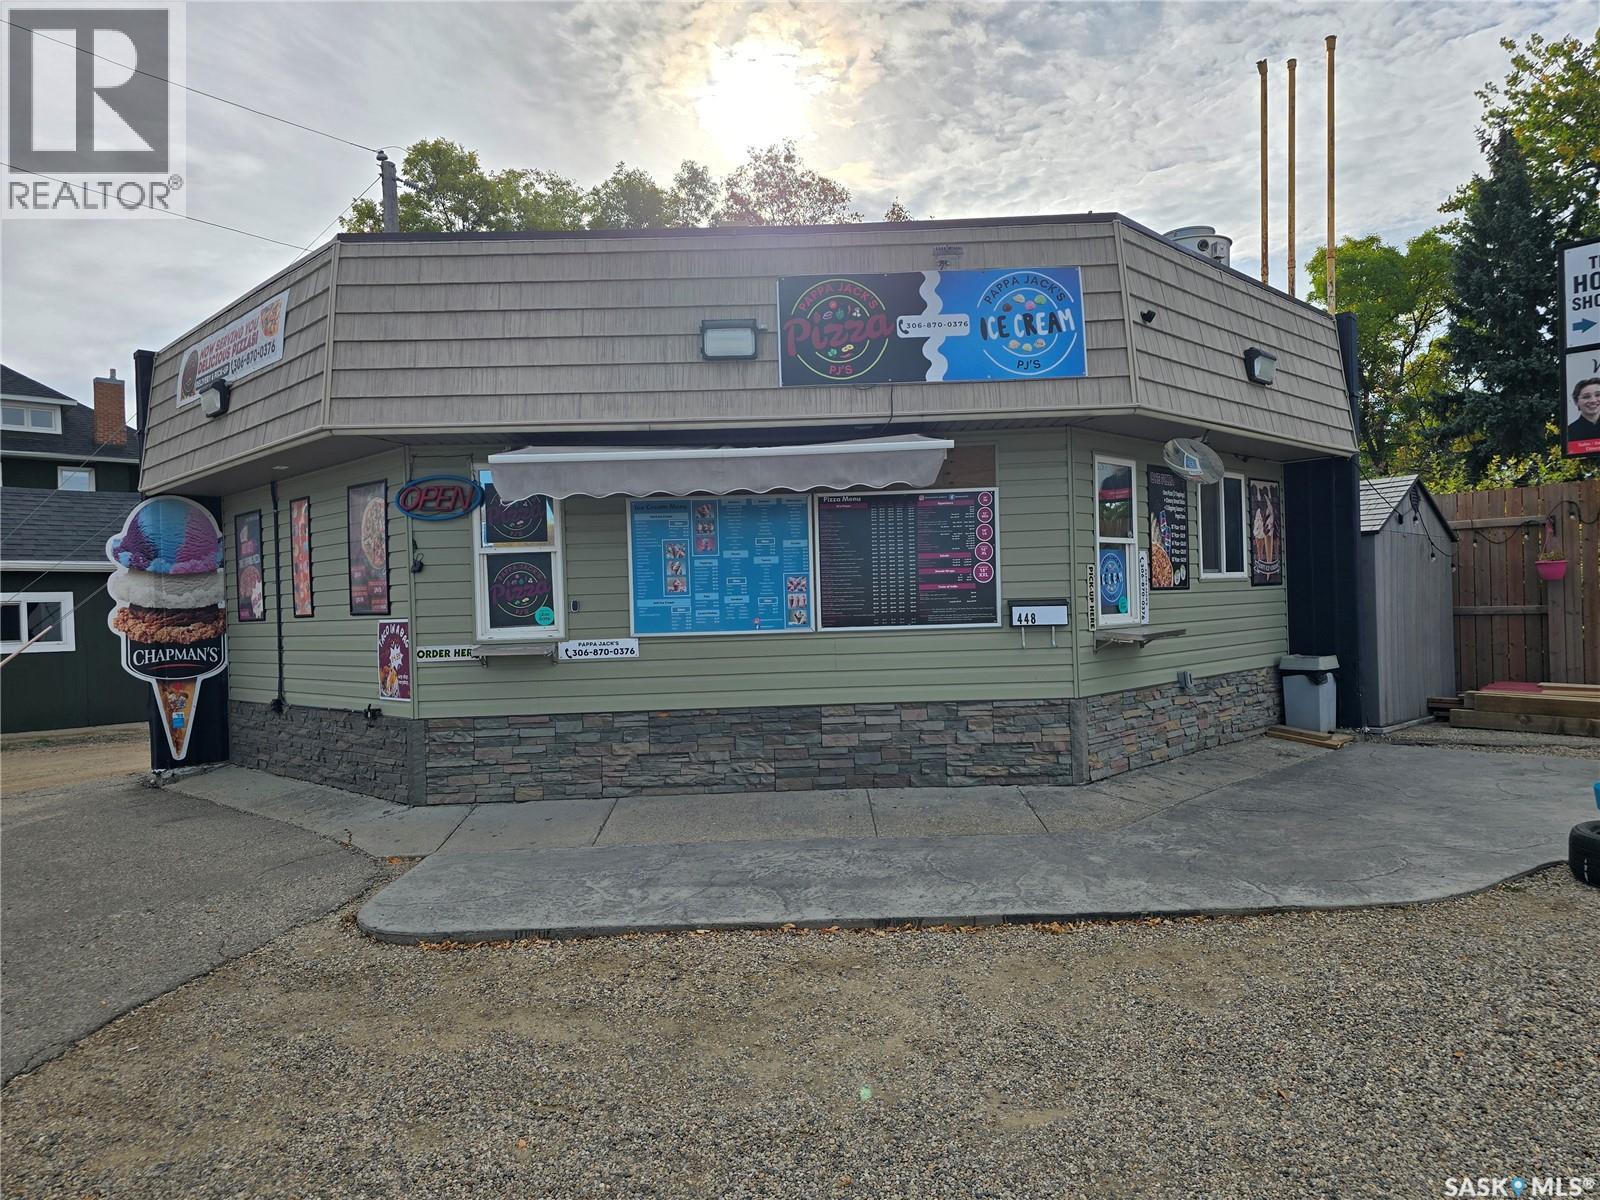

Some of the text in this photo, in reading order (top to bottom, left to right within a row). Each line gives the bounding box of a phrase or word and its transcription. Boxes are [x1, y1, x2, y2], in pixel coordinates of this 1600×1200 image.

[799, 283, 879, 311] PAPPA JACK'S
[984, 275, 1066, 304] PAPPA JACK'S
[906, 321, 969, 329] 306-870-0376
[980, 308, 1076, 341] ICE CREAM
[783, 313, 896, 356] Pizza
[829, 365, 854, 375] PJ'S
[1017, 360, 1041, 370] PJ'S
[400, 485, 474, 512] OPEN
[1017, 612, 1037, 625] 448
[132, 646, 219, 666] CHAPMAN'S
[416, 648, 475, 659] ORDER HER
[572, 647, 636, 657] 306-870-0376
